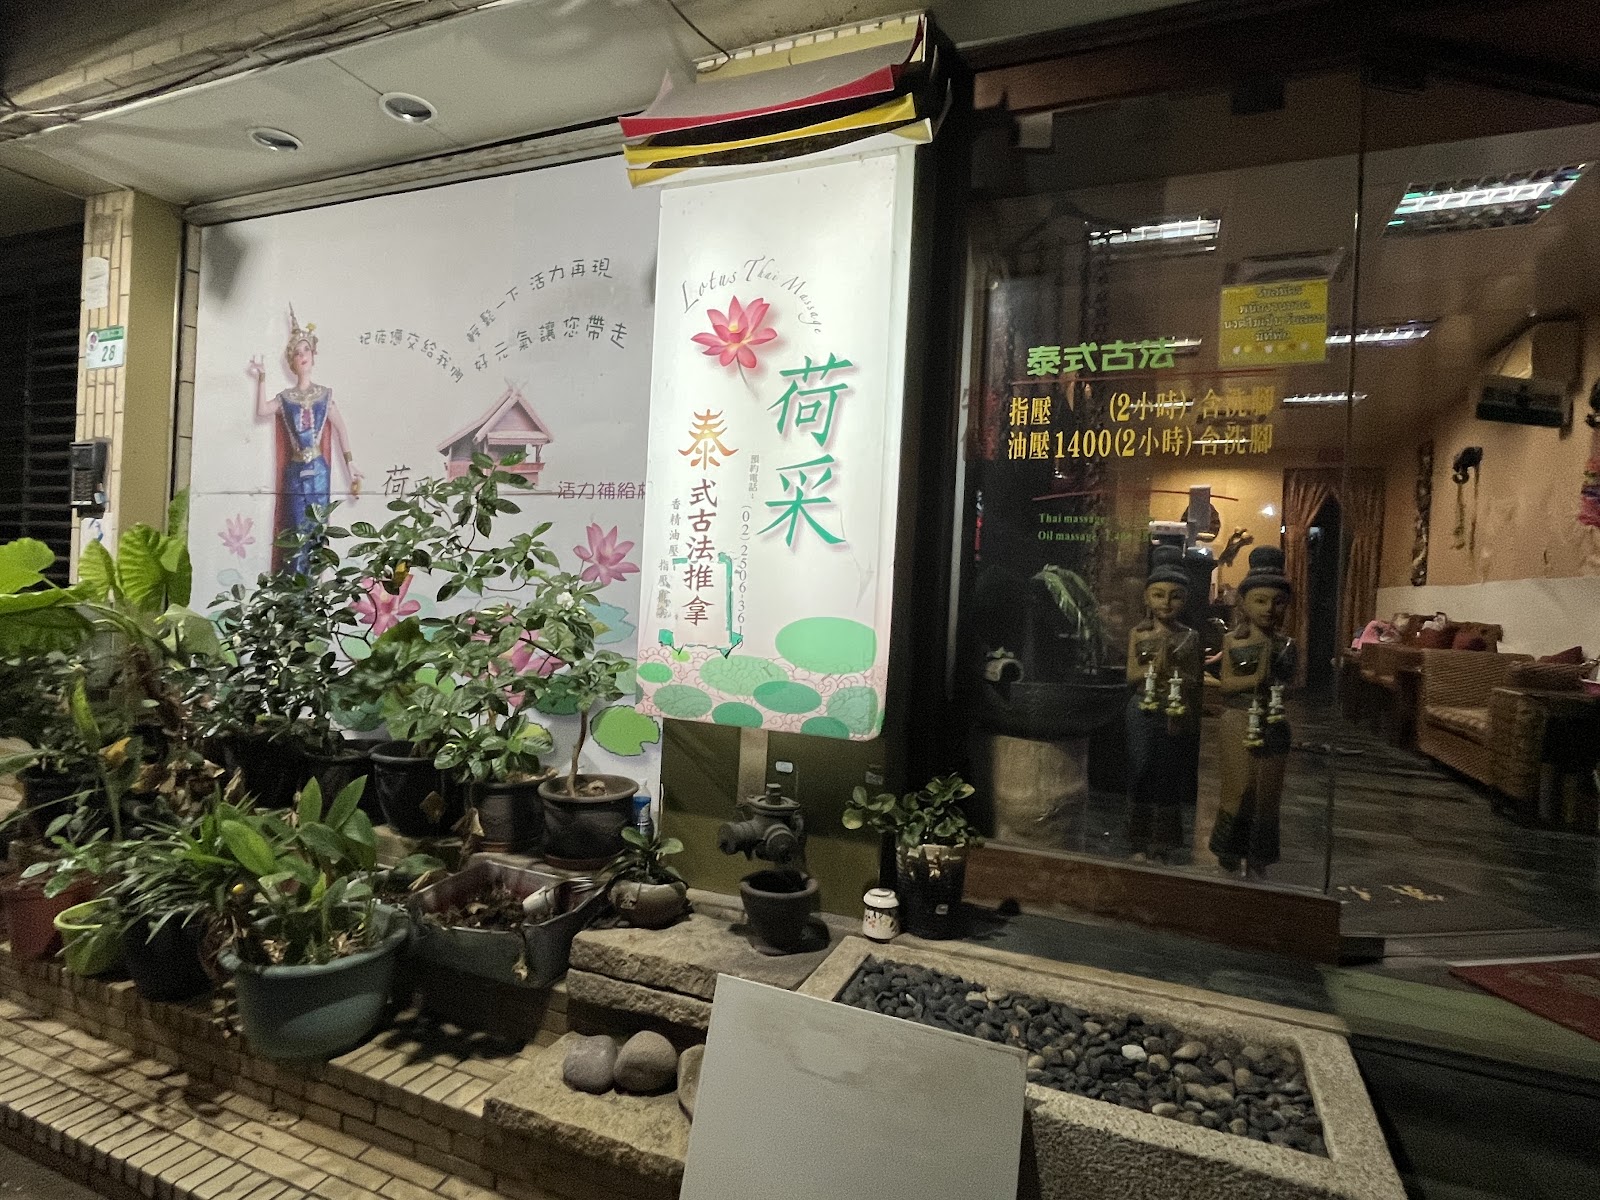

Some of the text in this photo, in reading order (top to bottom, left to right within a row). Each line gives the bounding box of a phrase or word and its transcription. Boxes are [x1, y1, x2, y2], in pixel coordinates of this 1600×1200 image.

[530, 258, 613, 290] 活力再現
[681, 256, 822, 334] Lotus Thai Massage
[101, 344, 116, 362] 28
[474, 314, 628, 372] 好元氣讓您帶走
[1026, 337, 1175, 376] 泰式古法
[1009, 396, 1051, 426] 指壓
[756, 352, 854, 549] 荷采
[677, 408, 739, 627] 泰式古法推拿
[1039, 513, 1105, 526] Thai massage
[1038, 530, 1053, 541] Oil
[1056, 531, 1097, 543] massage
